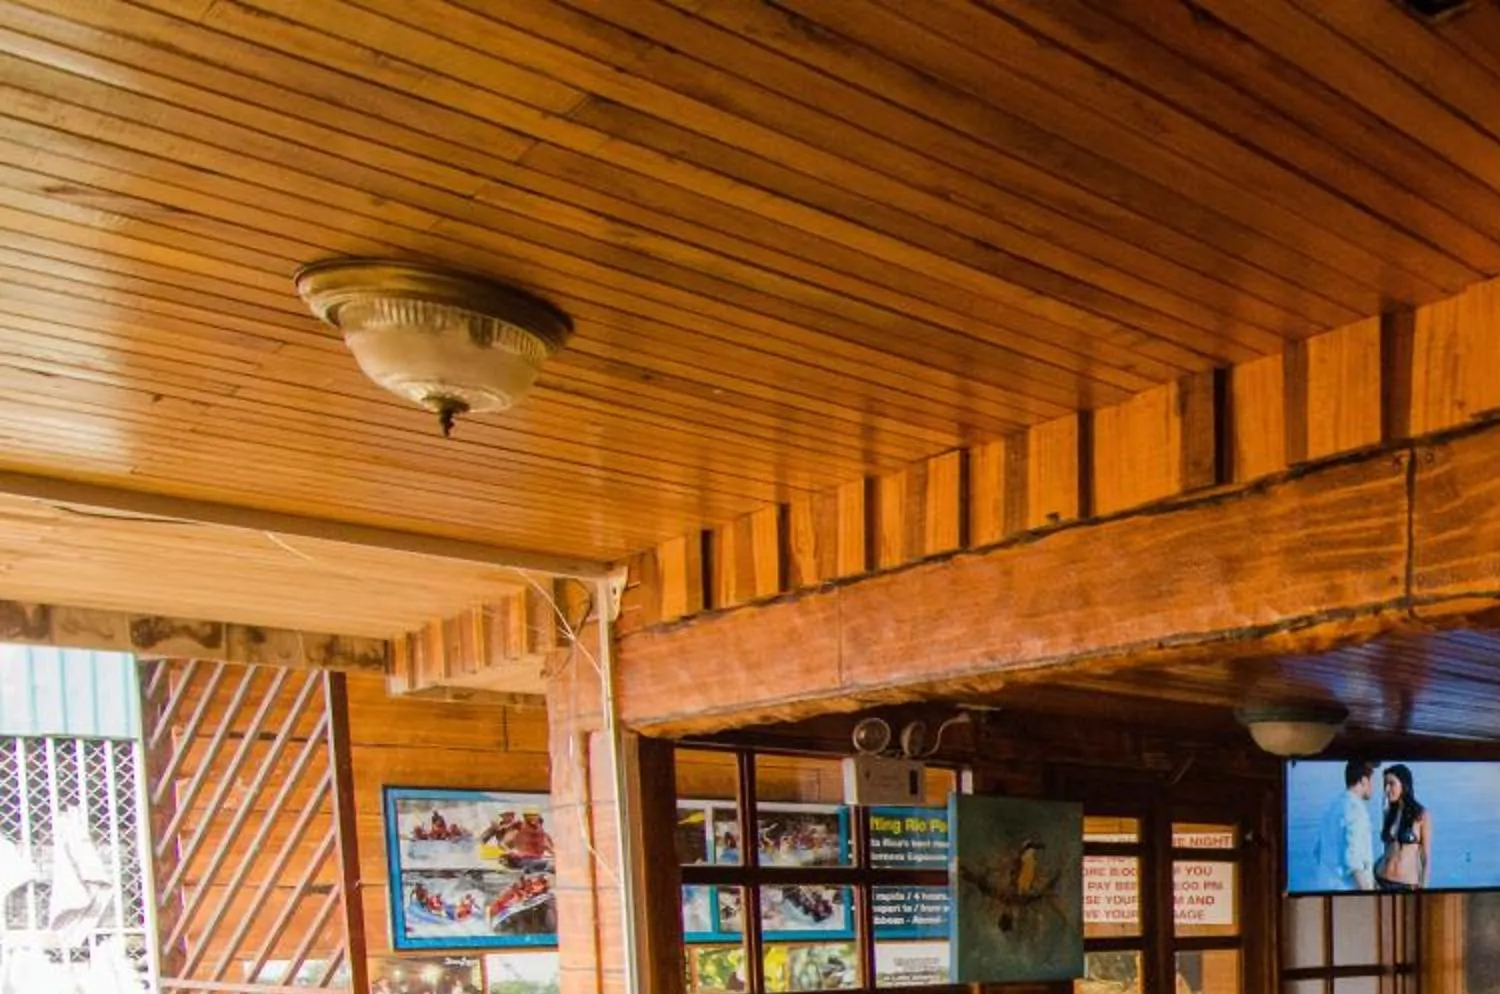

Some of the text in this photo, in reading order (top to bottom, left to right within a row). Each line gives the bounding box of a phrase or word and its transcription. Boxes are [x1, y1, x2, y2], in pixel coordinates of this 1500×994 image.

[1189, 834, 1231, 848] NIGHT
[1184, 865, 1213, 877] YOU
[1086, 881, 1112, 891] PAY
[1186, 894, 1216, 906] AND
